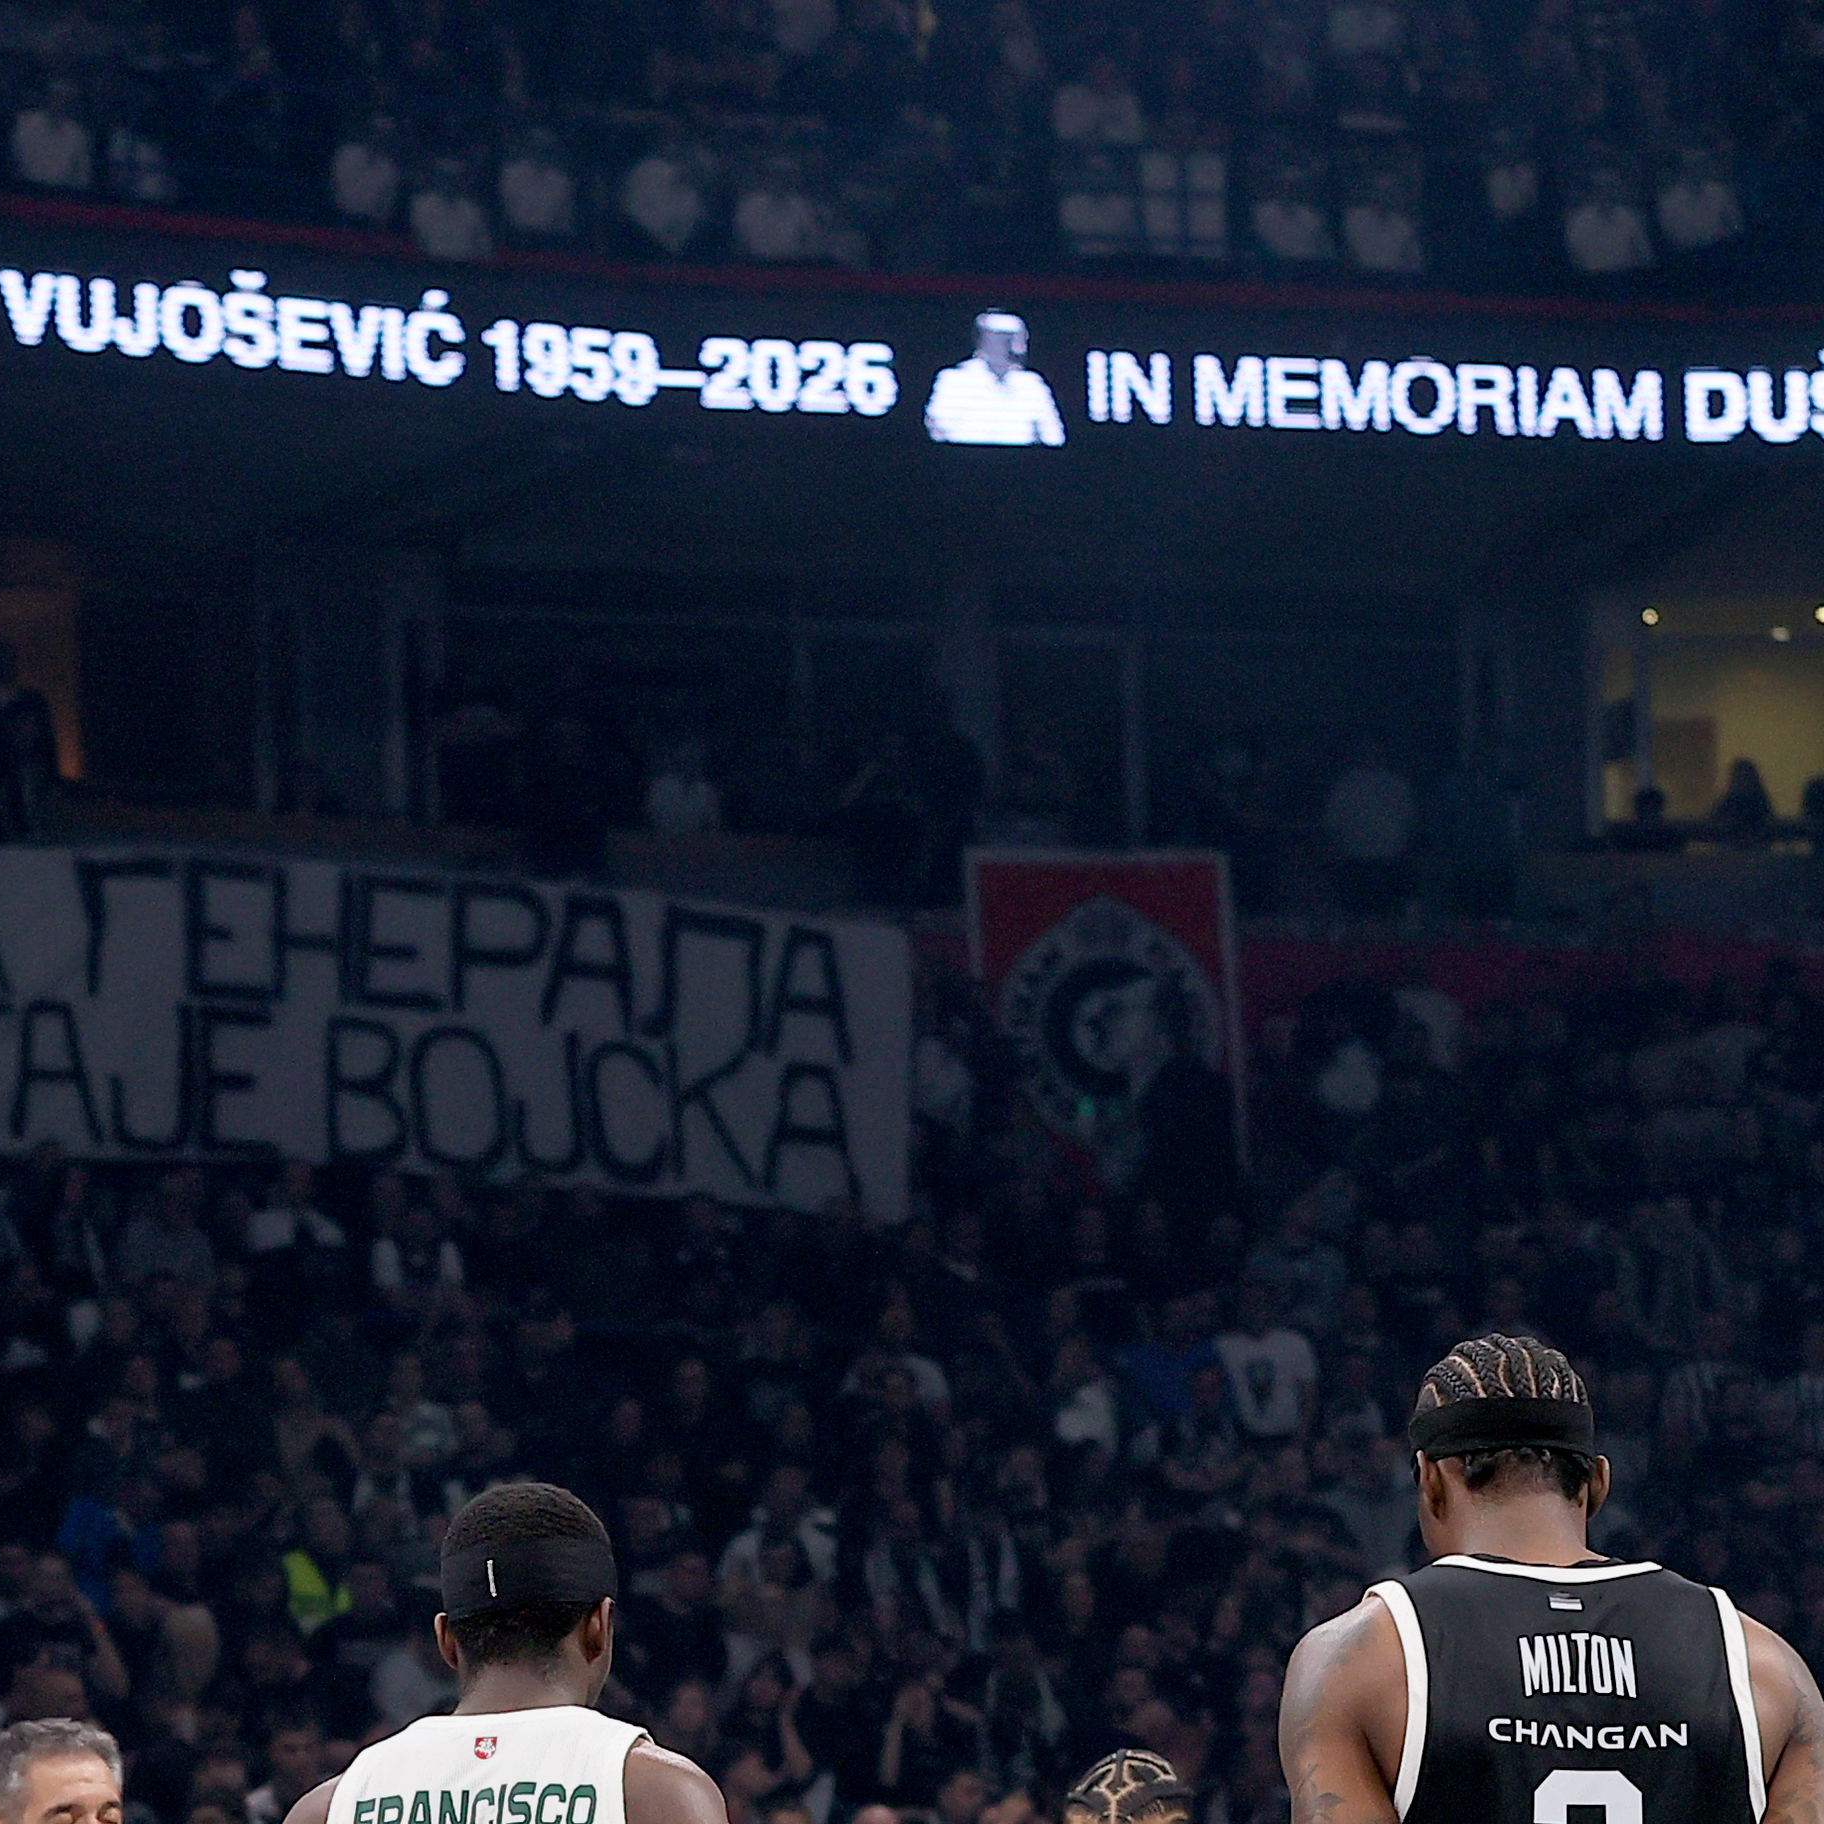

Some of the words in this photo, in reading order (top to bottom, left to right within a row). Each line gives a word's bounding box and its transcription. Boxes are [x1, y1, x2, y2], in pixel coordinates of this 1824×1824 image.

[1086, 349, 1172, 425] IN
[1193, 354, 1664, 442] MEMORIAM
[1518, 1632, 1638, 1699] MILTON
[1488, 1717, 1689, 1750] CHANGAN
